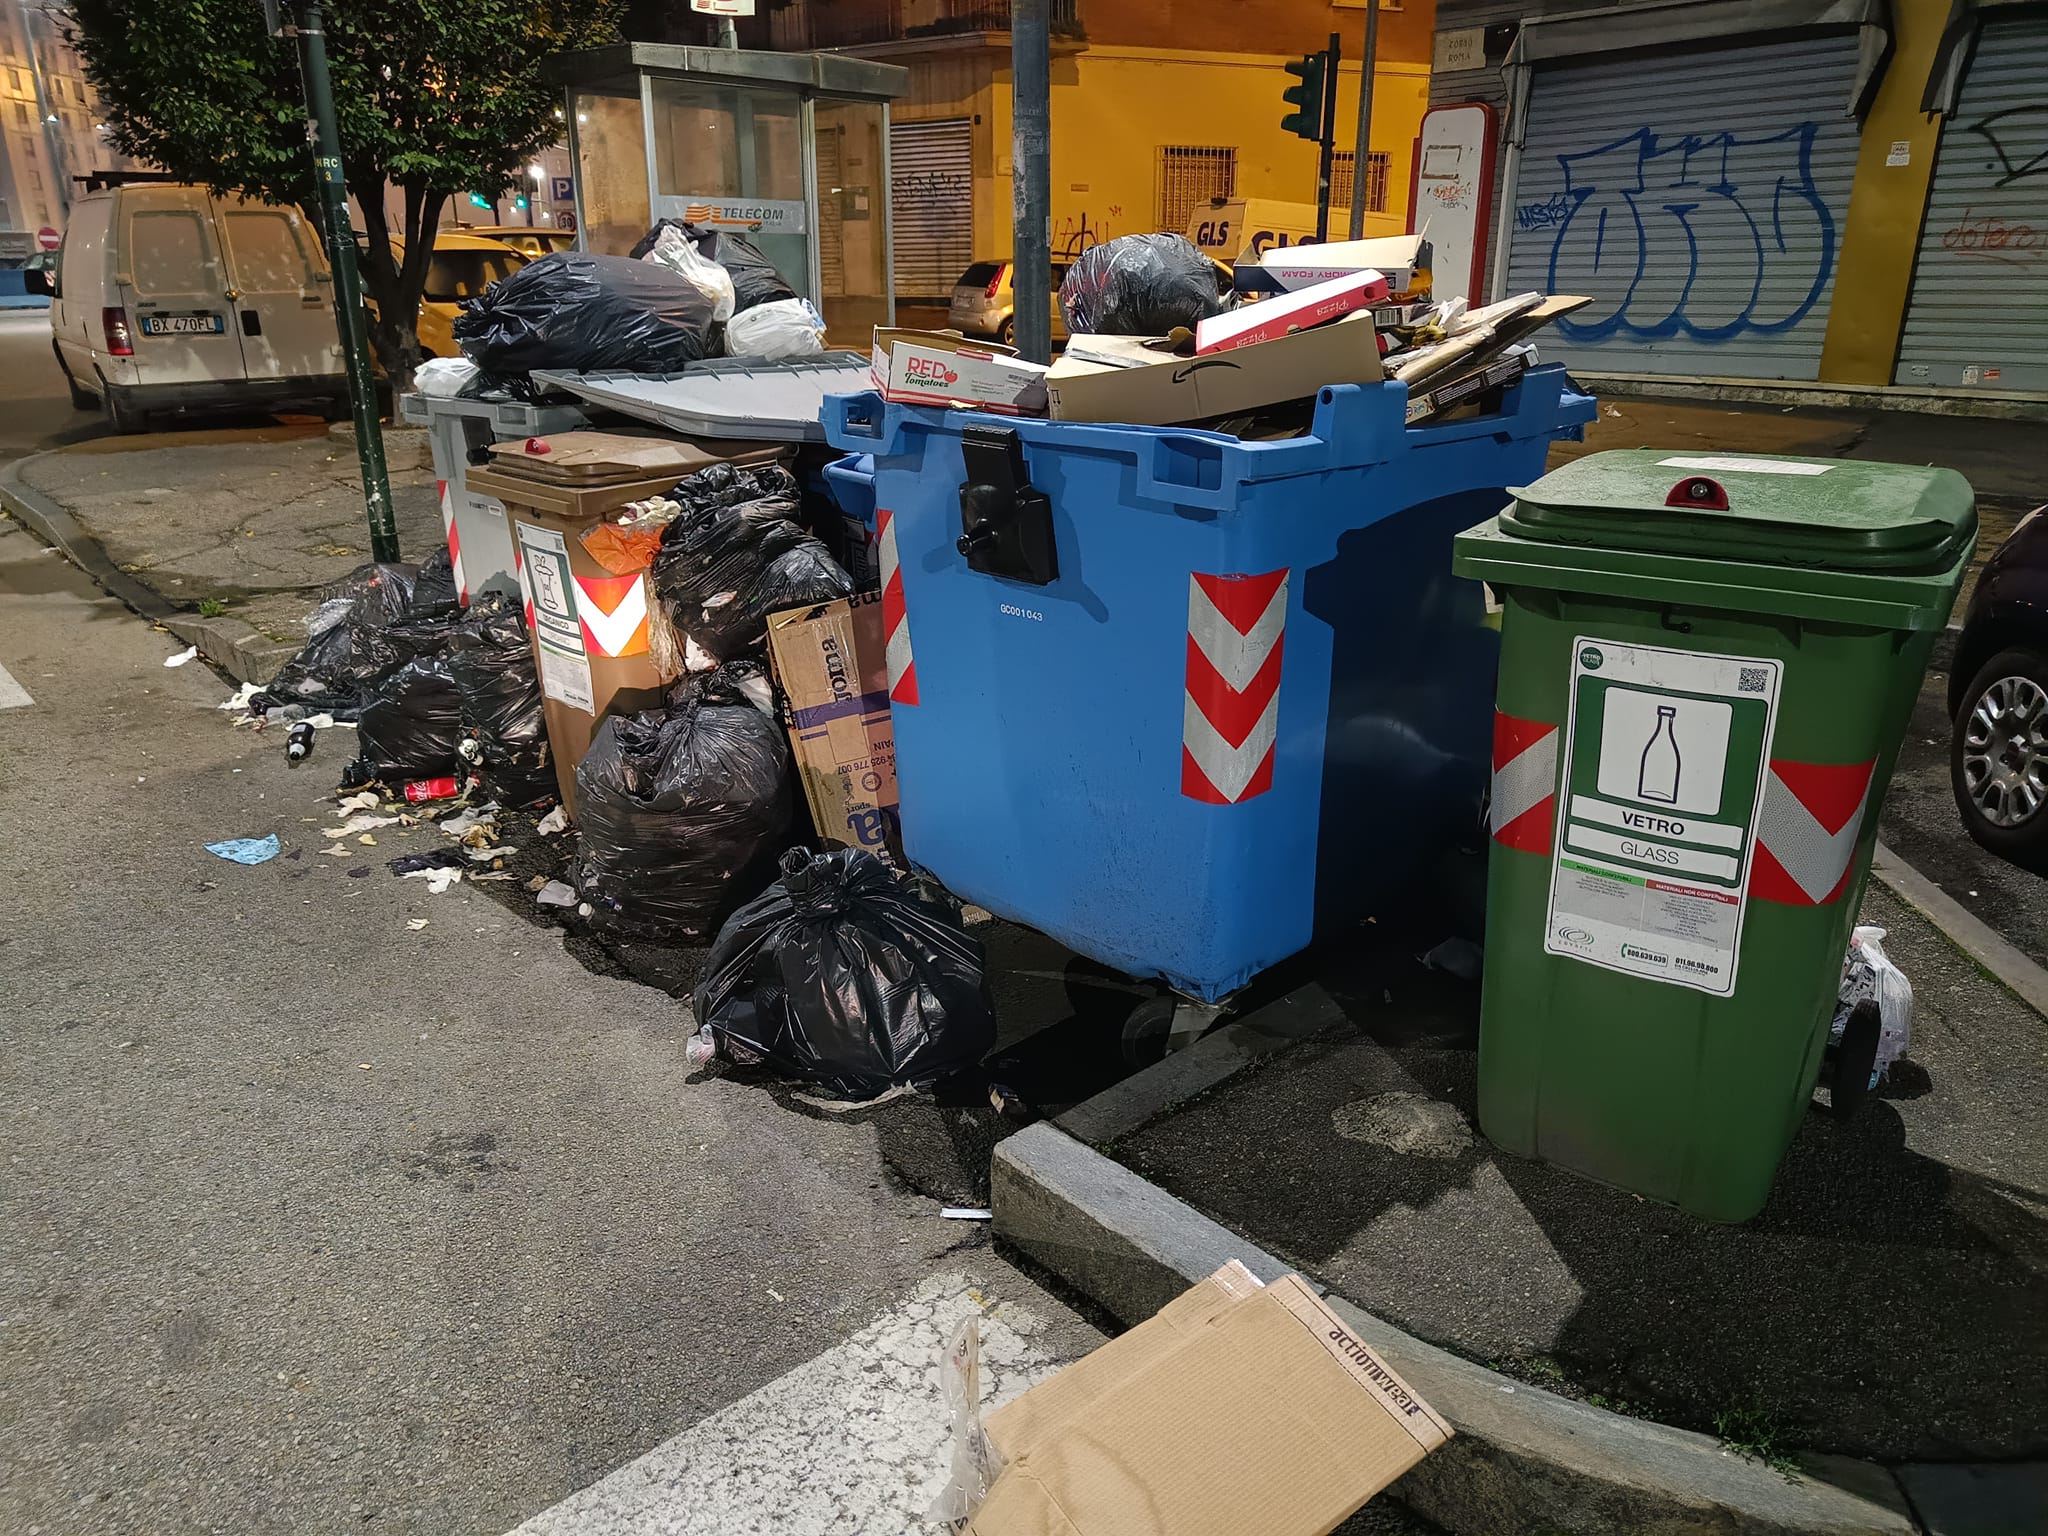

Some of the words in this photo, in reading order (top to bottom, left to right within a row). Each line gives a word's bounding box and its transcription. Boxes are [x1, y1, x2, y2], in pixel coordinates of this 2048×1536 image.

[557, 181, 570, 198] P
[723, 207, 784, 220] TELECOM
[561, 217, 573, 228] 30
[1197, 221, 1229, 246] GLS
[152, 320, 169, 331] BX
[174, 318, 214, 331] 470FL
[907, 356, 947, 379] RED
[904, 372, 950, 388] Tomatoes
[847, 802, 871, 814] sport
[1622, 811, 1685, 836] VETRO
[1620, 841, 1680, 865] GLASS
[1656, 883, 1683, 894] MATERIALI
[1329, 1329, 1420, 1417] actionwear
